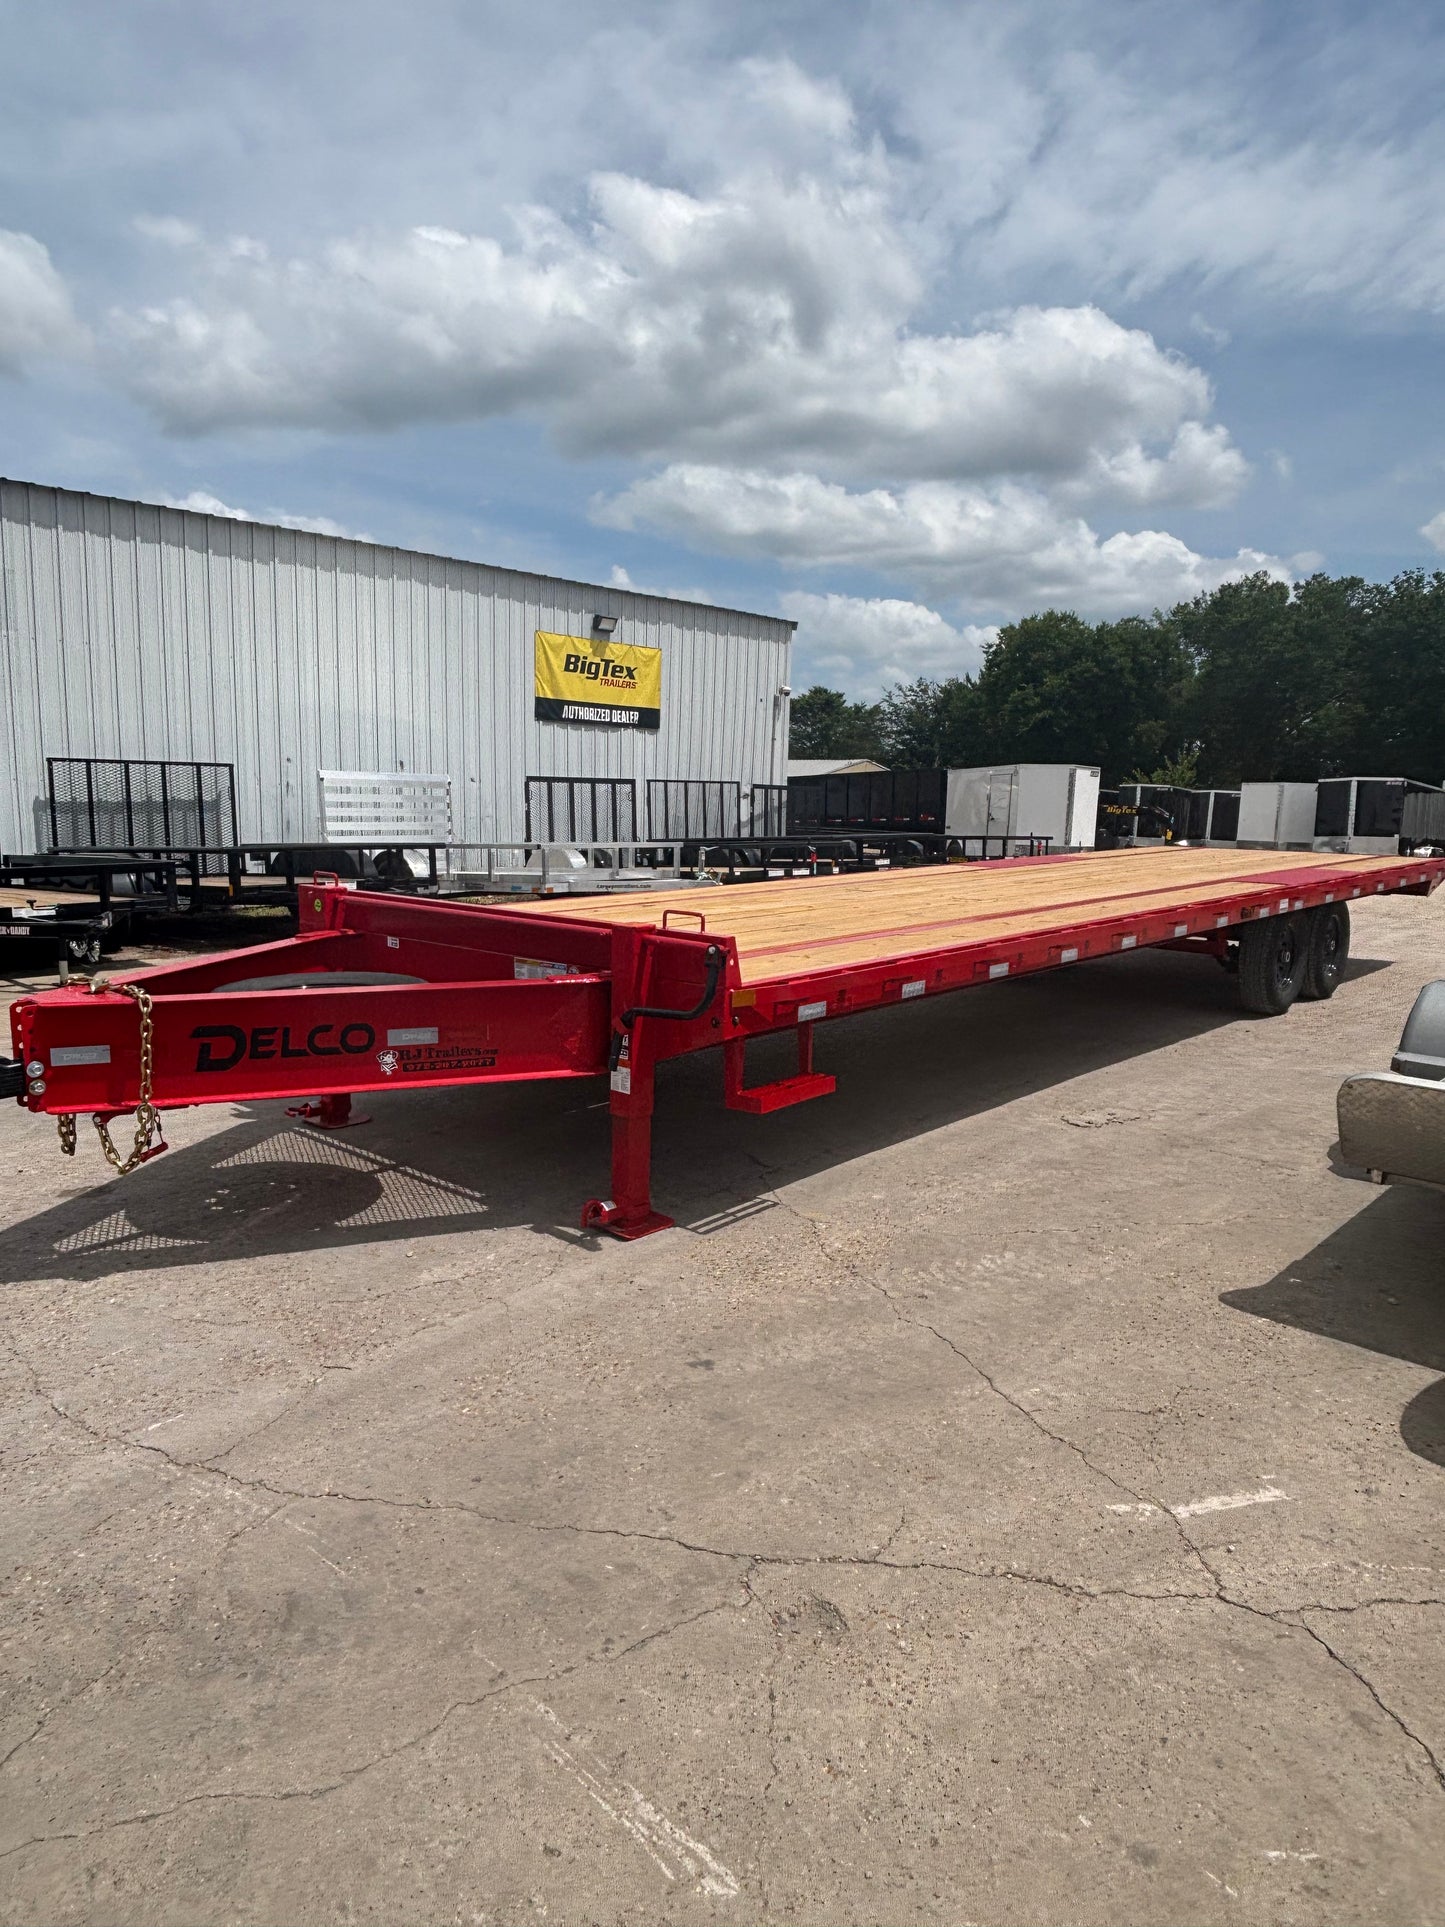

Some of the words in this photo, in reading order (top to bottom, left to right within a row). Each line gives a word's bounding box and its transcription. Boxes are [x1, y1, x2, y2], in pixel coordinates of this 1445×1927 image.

[564, 653, 638, 680] BigTex
[600, 677, 637, 689] TRAILERS
[562, 705, 610, 722] AUTHORIZED
[612, 709, 639, 724] DEALER
[190, 1023, 375, 1072] DELCO
